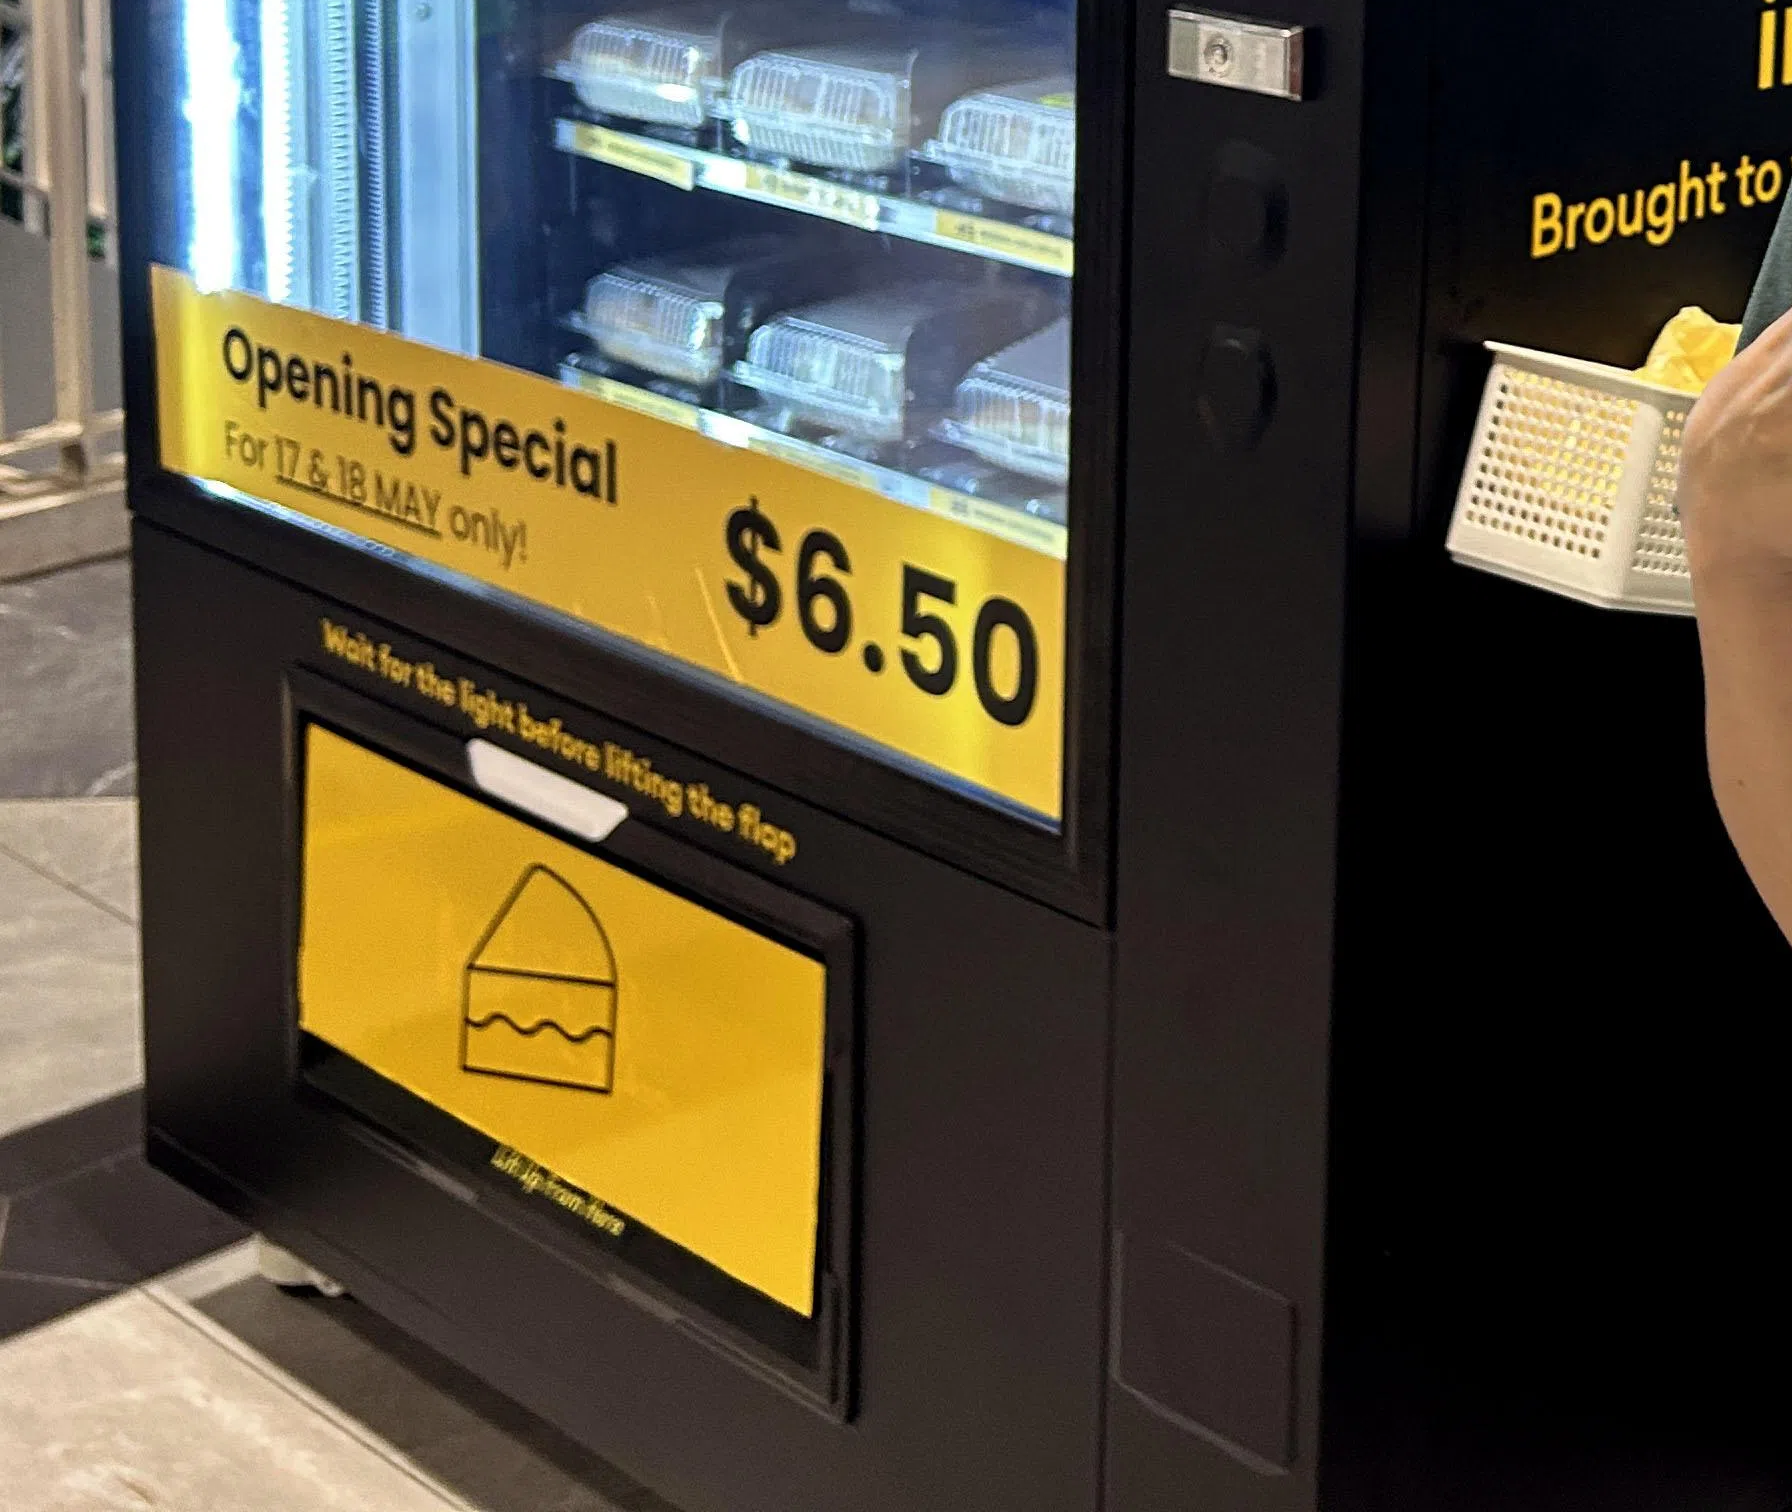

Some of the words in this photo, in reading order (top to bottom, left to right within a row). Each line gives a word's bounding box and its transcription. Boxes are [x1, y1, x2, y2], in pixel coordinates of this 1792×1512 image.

[1531, 160, 1726, 258] Brought
[1736, 155, 1782, 207] to
[222, 328, 416, 455] Opening
[429, 388, 618, 504] Special
[224, 420, 266, 470] For
[277, 434, 302, 477] 17
[308, 450, 329, 489] &
[338, 454, 366, 504] 18
[375, 474, 441, 530] MAY
[449, 505, 528, 569] only!
[725, 495, 1038, 726] $6.50
[320, 618, 376, 672] Wait
[378, 643, 412, 687] for
[415, 662, 456, 707] the
[457, 676, 515, 734] light
[517, 702, 600, 772] before
[604, 741, 683, 818] lifting
[687, 782, 735, 833] the
[737, 802, 796, 865] flap
